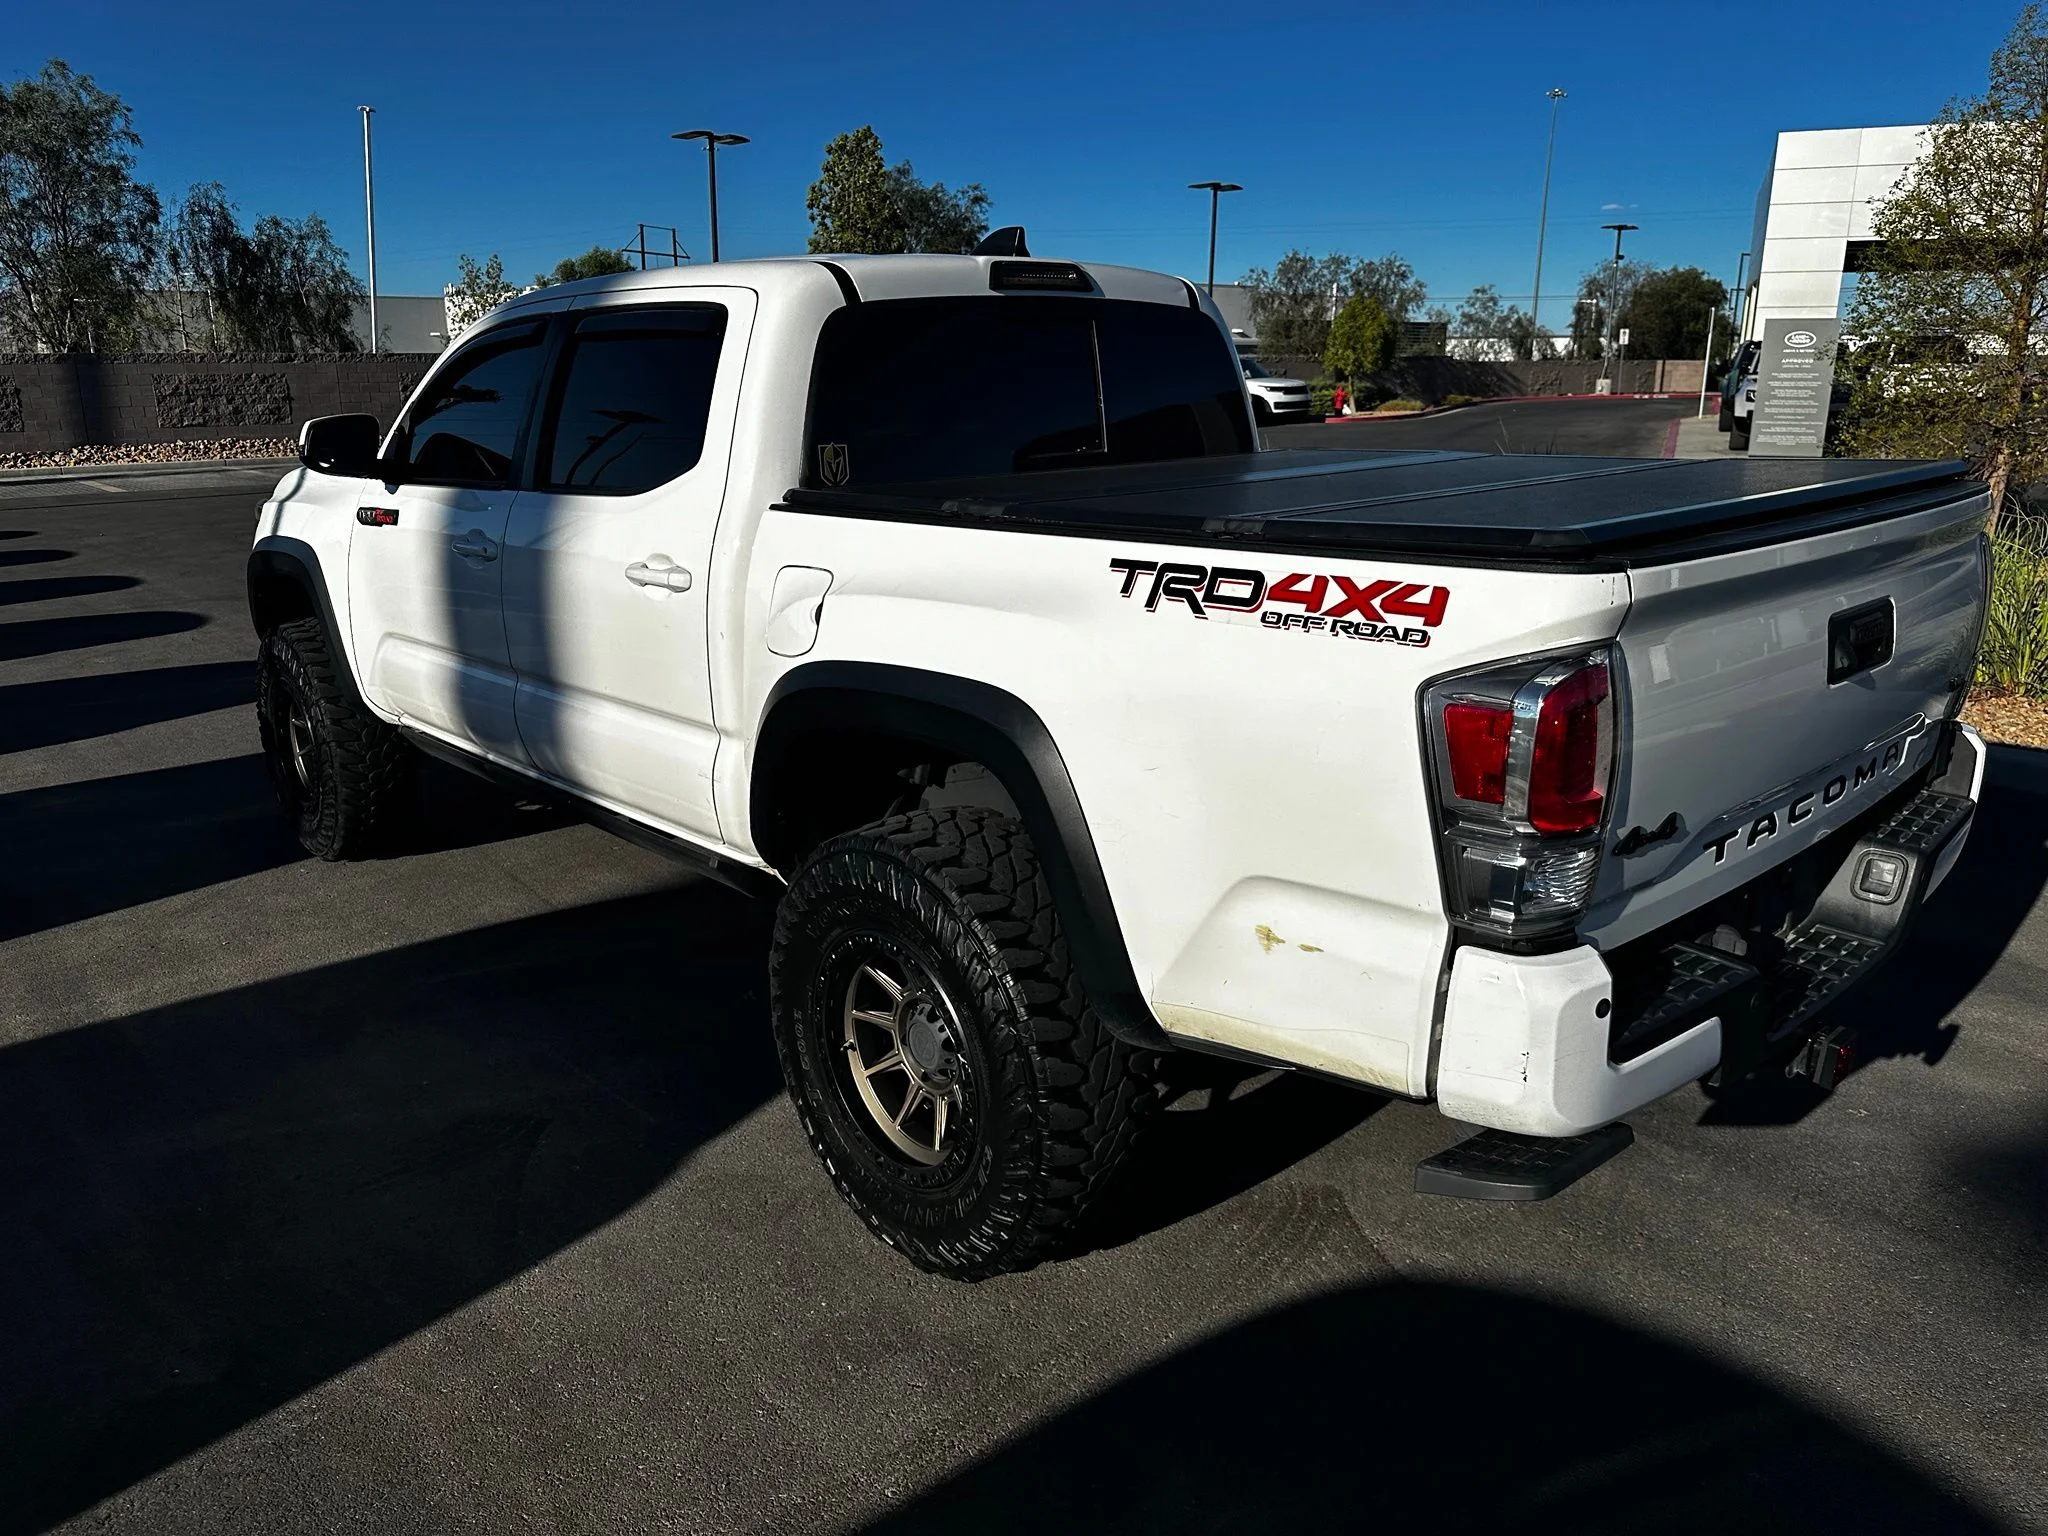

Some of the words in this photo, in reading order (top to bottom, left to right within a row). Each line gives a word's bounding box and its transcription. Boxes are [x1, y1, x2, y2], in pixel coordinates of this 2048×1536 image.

[1109, 557, 1267, 620] TRD
[1266, 572, 1451, 628] 4X4
[1260, 610, 1328, 633] OFF
[1329, 619, 1431, 648] ROAD
[1703, 740, 1900, 866] TACOMA
